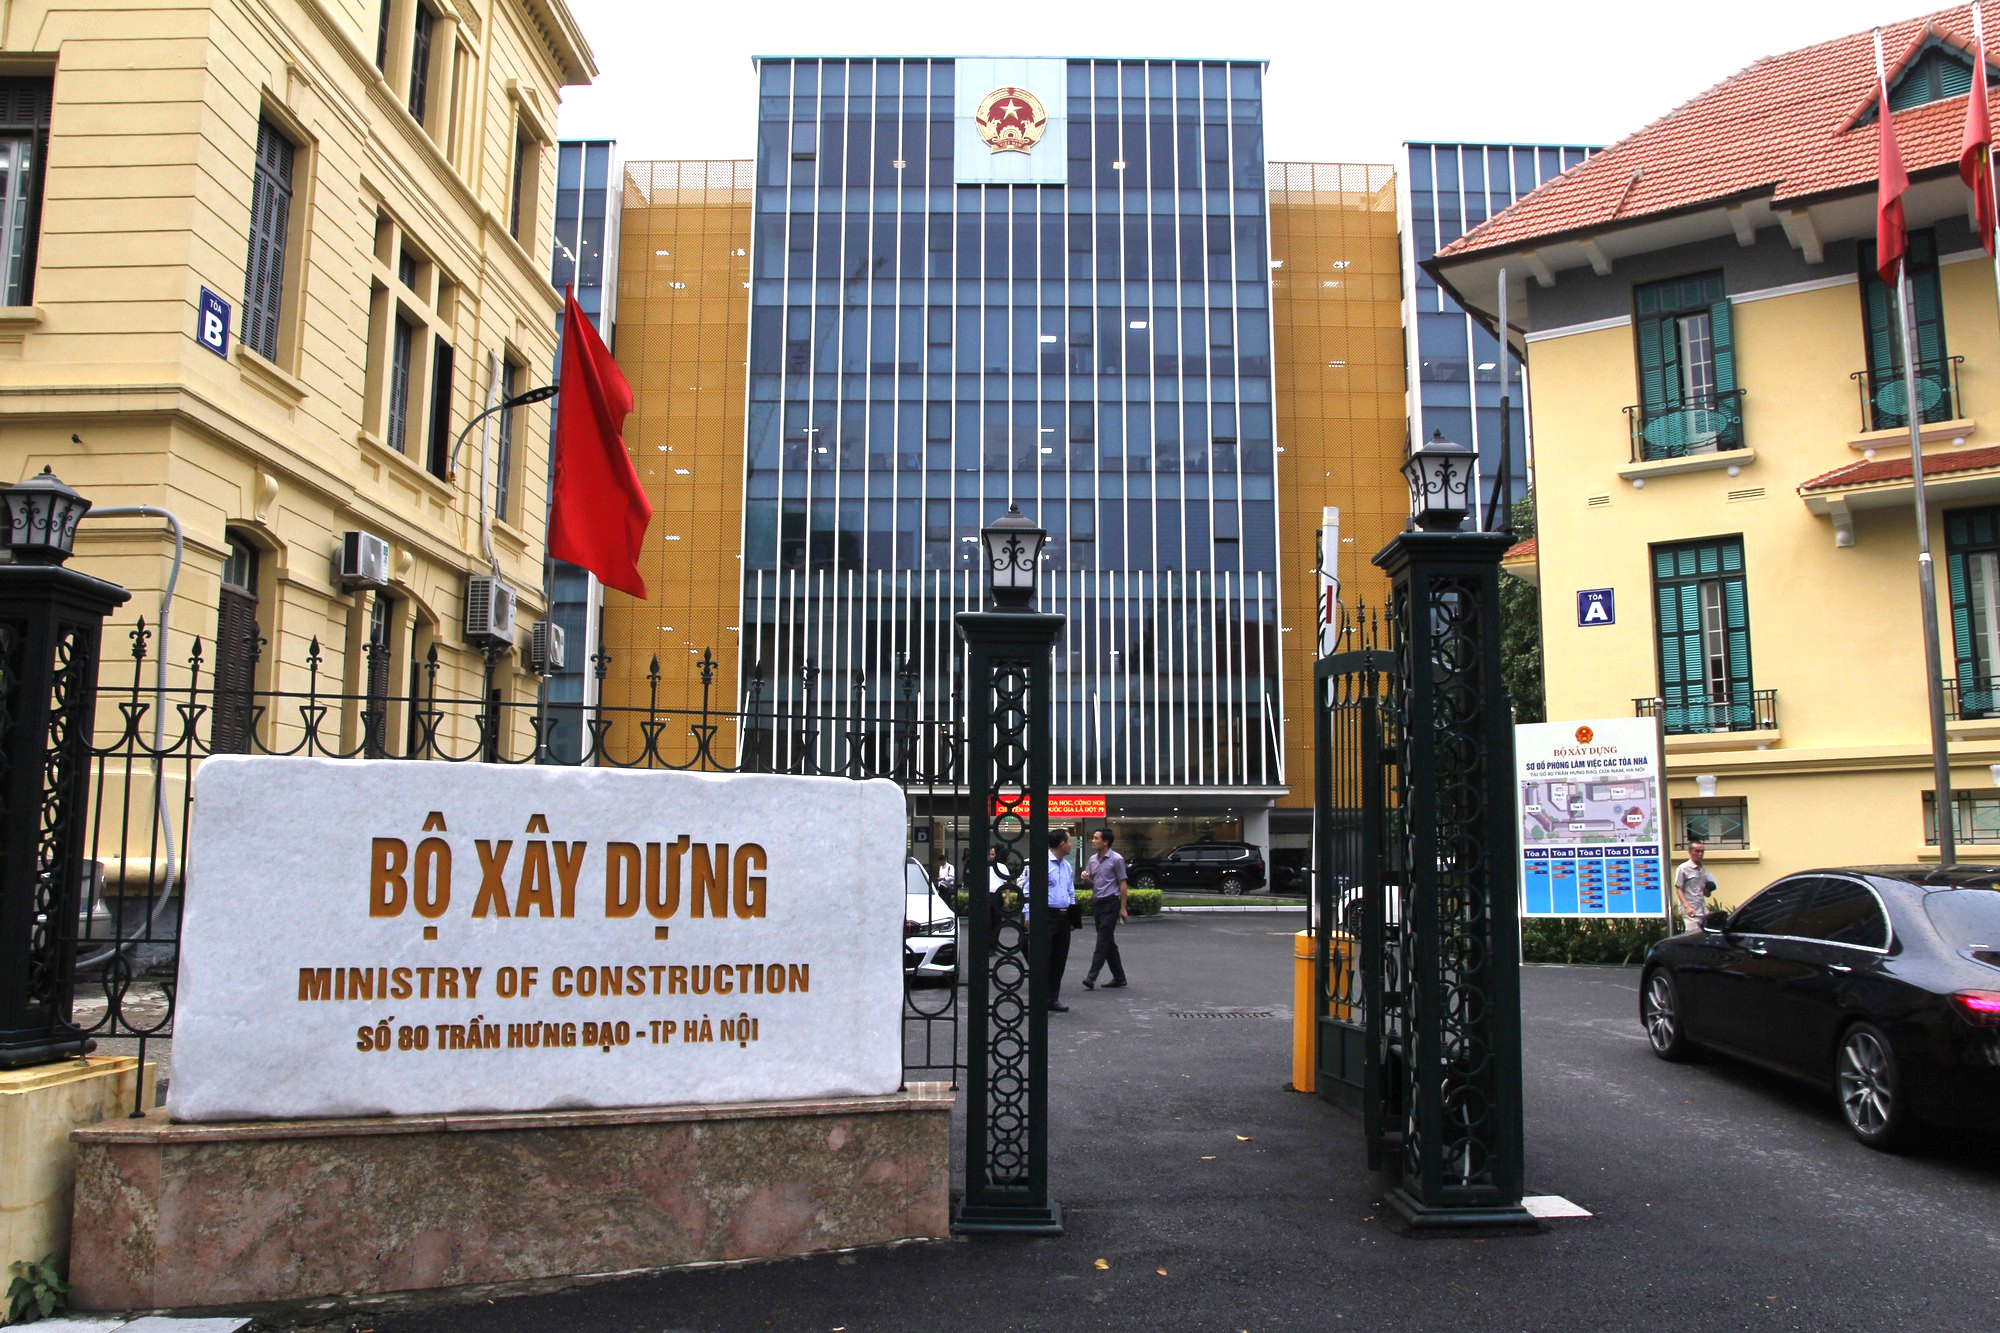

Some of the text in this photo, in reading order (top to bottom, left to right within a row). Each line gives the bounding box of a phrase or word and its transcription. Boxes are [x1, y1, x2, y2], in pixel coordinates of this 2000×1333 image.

[210, 299, 222, 313] TÒA
[204, 310, 223, 347] B
[1584, 601, 1608, 621] A
[1547, 759, 1569, 770] PHÒNG
[1571, 759, 1585, 768] LÀM
[1587, 758, 1601, 769] VIỆC
[1619, 757, 1632, 766] TÒA
[1633, 756, 1648, 765] NHÀ
[1553, 746, 1617, 758] BỘ XÂY DỰNG
[368, 811, 768, 940] BỘ XÂY DỰNG
[298, 963, 810, 1001] MINISTRY OF CONSTRUCTION
[356, 1015, 395, 1053] SỐ
[398, 1025, 429, 1052] 80
[436, 1014, 501, 1051] TRẦN
[507, 1020, 577, 1049] HƯNG
[581, 1021, 630, 1053] ĐẠO
[683, 1013, 713, 1043] HÀ
[720, 1012, 759, 1049] NỘI
